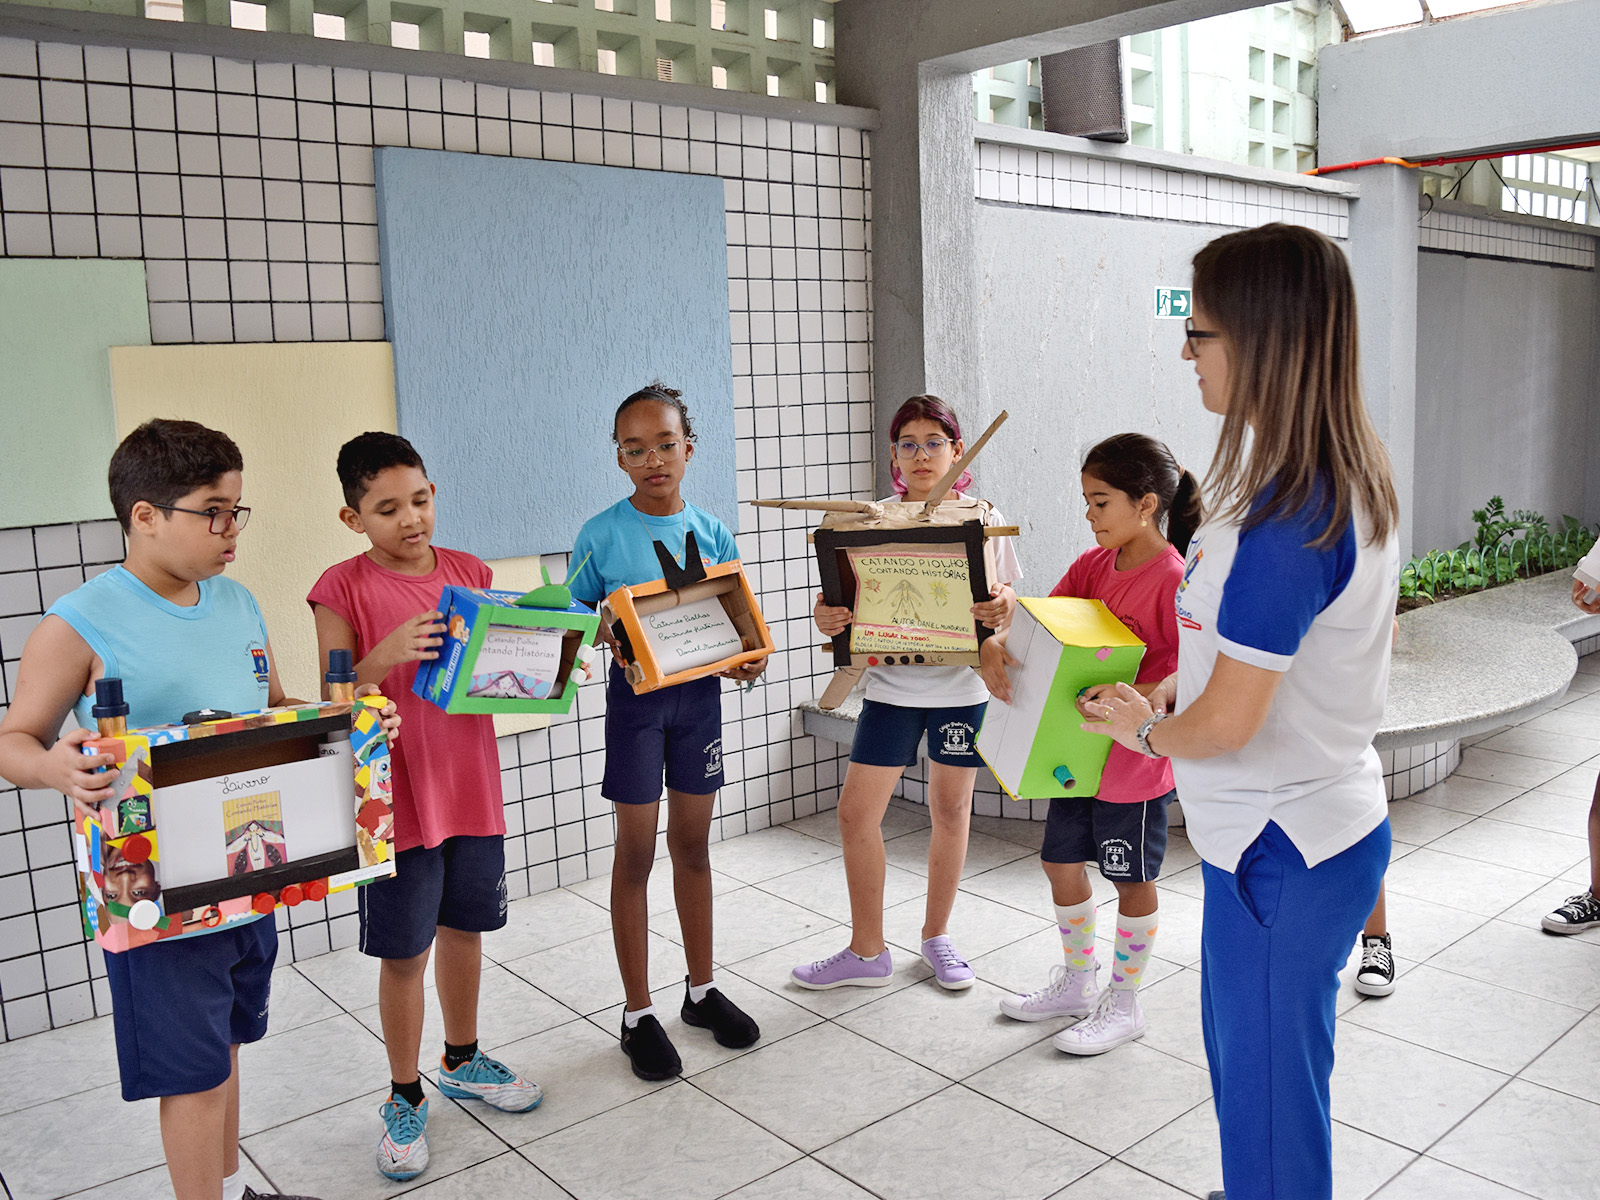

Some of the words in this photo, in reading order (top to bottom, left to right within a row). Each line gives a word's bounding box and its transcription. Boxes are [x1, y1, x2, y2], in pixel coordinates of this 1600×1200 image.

[861, 557, 915, 567] CATANDO
[919, 558, 969, 570] PIOLHOS
[868, 567, 919, 576] CONTANDO
[649, 614, 683, 630] Catando
[891, 617, 915, 626] AUTOR
[487, 634, 516, 646] Catando
[516, 636, 540, 647] Piolhos
[657, 629, 693, 642] Contando
[514, 647, 556, 660] Histórias
[216, 774, 271, 795] Livro
